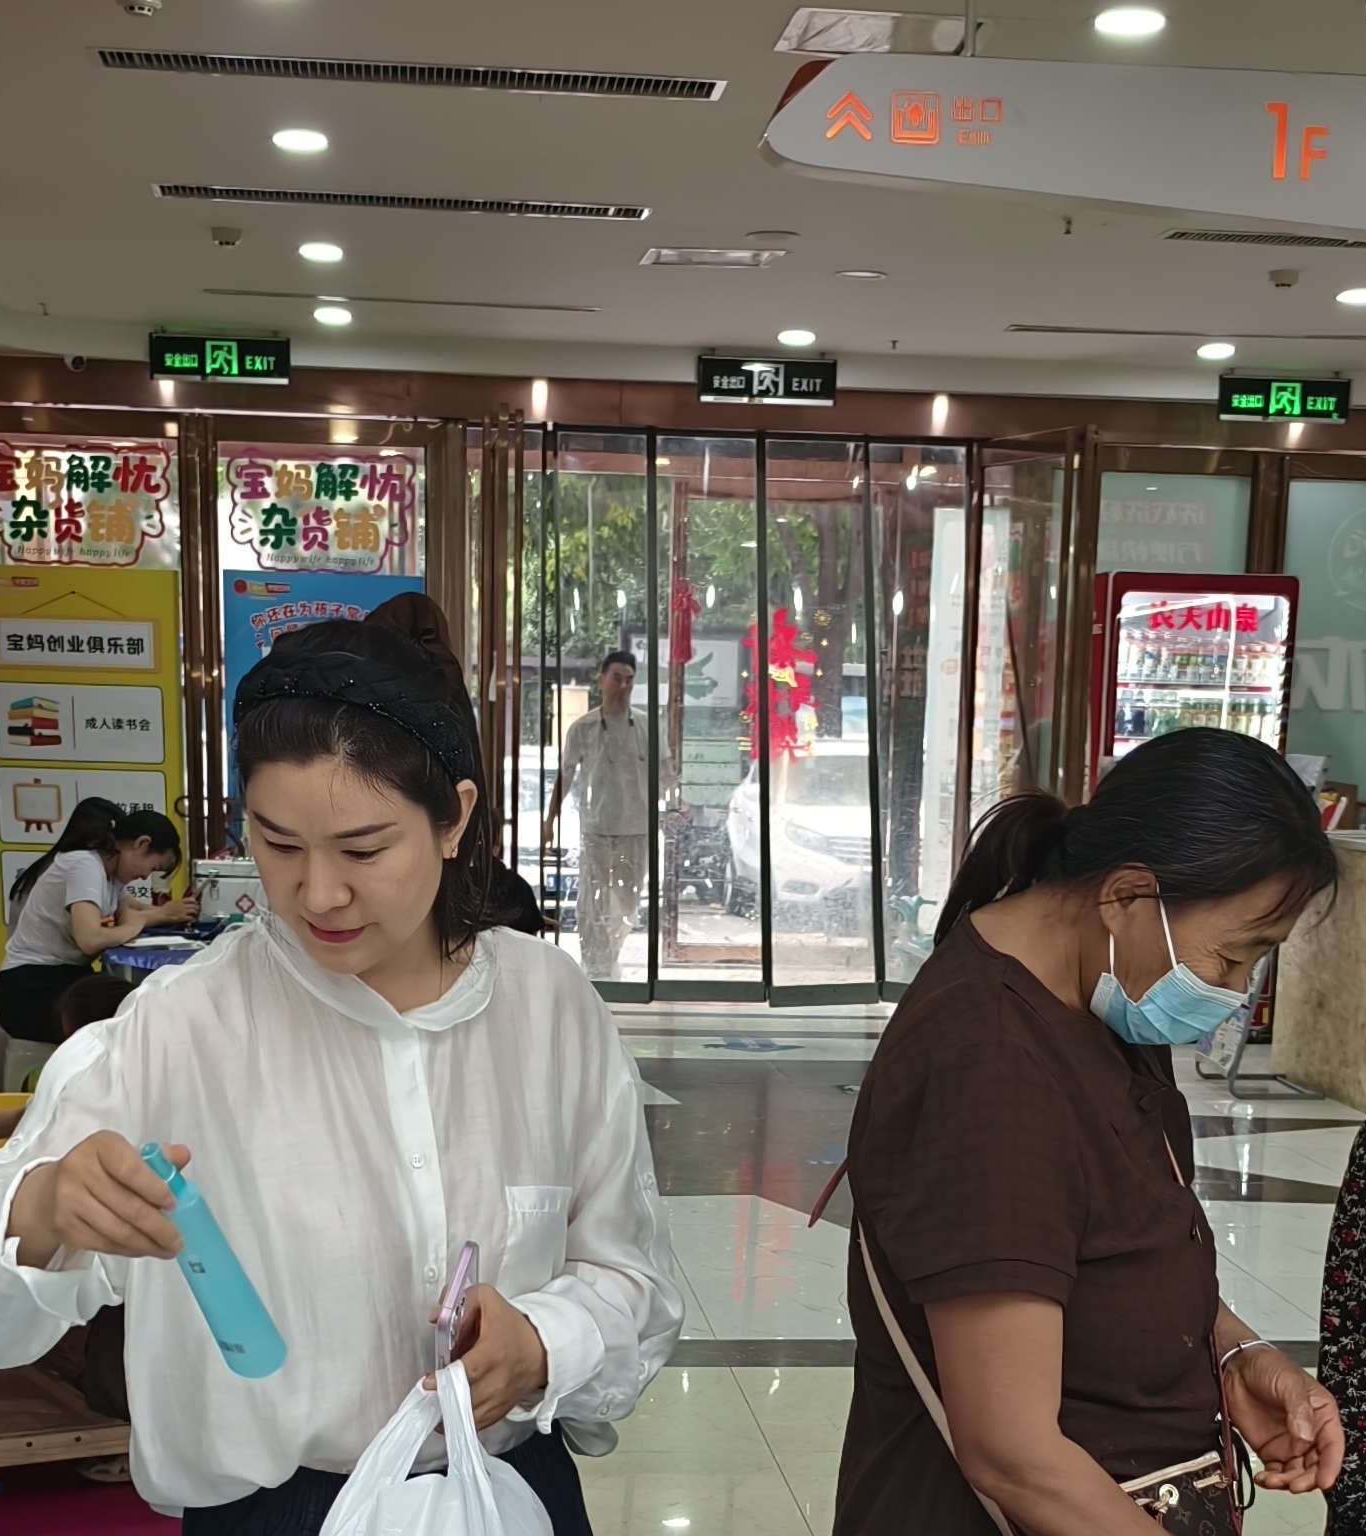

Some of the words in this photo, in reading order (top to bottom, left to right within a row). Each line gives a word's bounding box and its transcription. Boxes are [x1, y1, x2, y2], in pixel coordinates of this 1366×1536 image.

[953, 97, 1002, 122] 出口
[1265, 102, 1329, 180] 1F
[245, 355, 276, 370] EXIT
[792, 377, 823, 392] EXIT
[1307, 396, 1337, 411] EXIT
[235, 462, 407, 503] 宝妈解忧
[9, 496, 135, 544] 杂货铺
[258, 502, 387, 553] 杂货铺
[265, 553, 300, 567] Happy
[6, 631, 146, 657] 宝妈创业俱乐部
[85, 718, 151, 731] 成人读书会
